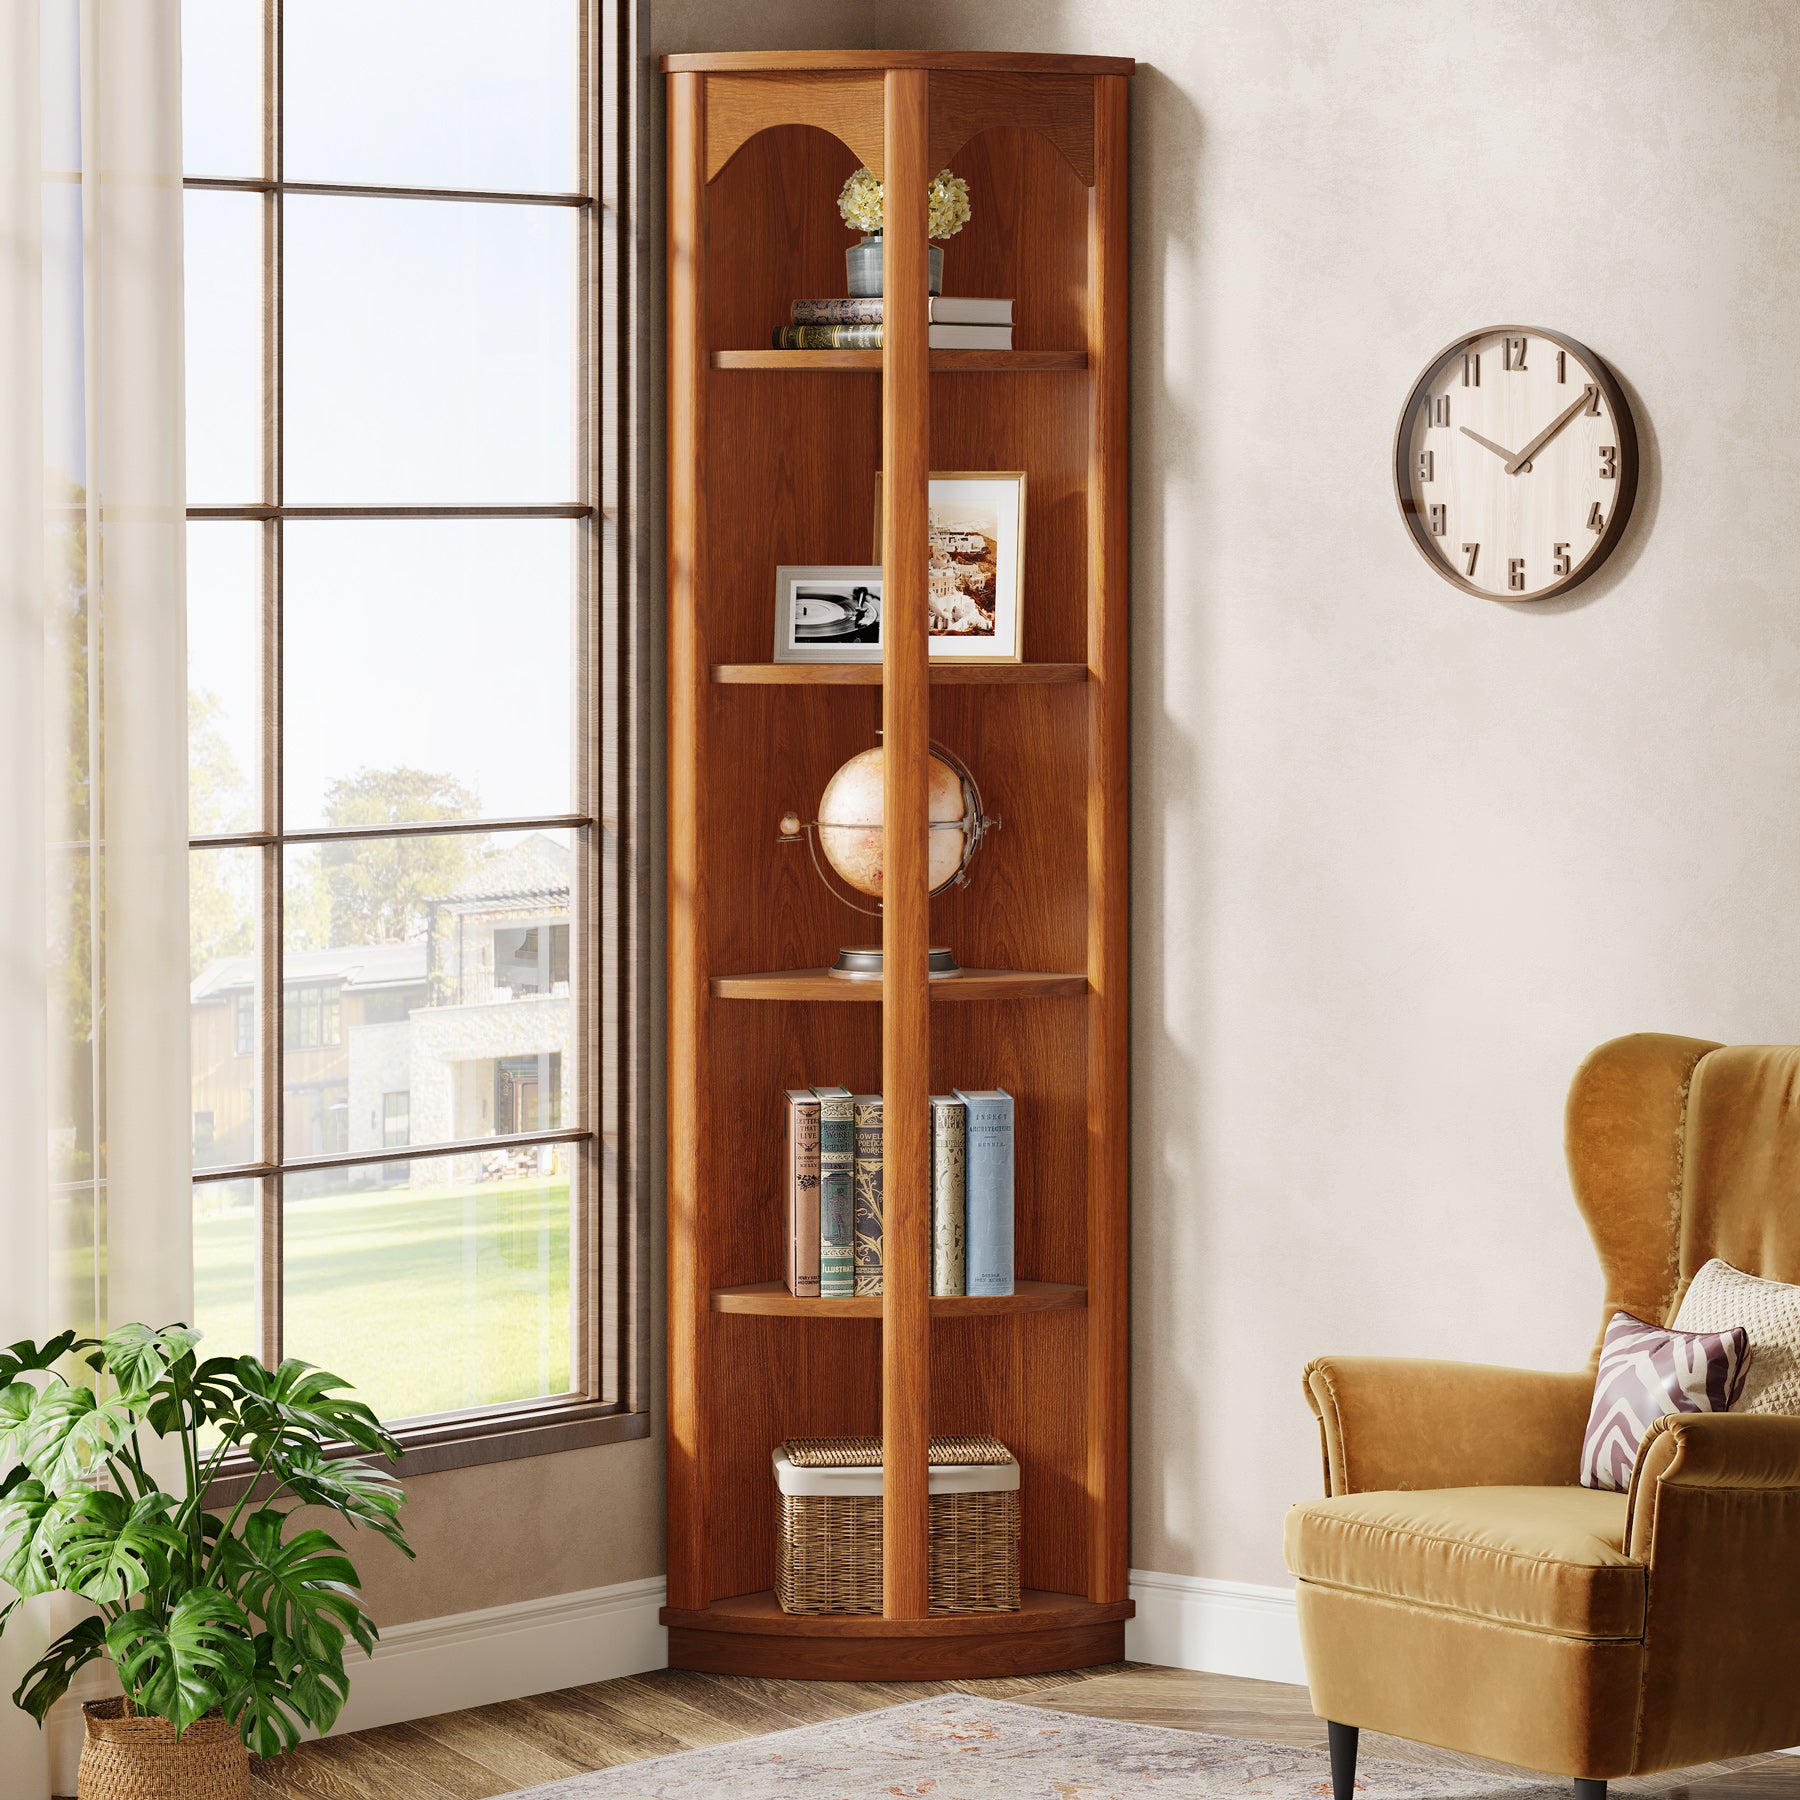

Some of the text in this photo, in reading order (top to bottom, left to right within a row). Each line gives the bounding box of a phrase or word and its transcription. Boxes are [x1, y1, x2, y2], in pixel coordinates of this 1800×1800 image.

[1460, 353, 1480, 387] 11
[1501, 337, 1527, 371] 12
[1556, 350, 1567, 384] 1
[1424, 394, 1450, 428] 10
[1584, 383, 1602, 417] 2
[1417, 450, 1434, 482] 9
[1599, 446, 1616, 479] 3
[1429, 503, 1446, 536] 8
[1586, 501, 1603, 534] 4
[1462, 543, 1480, 576] 7
[1507, 558, 1525, 590] 6
[1553, 543, 1571, 576] 5
